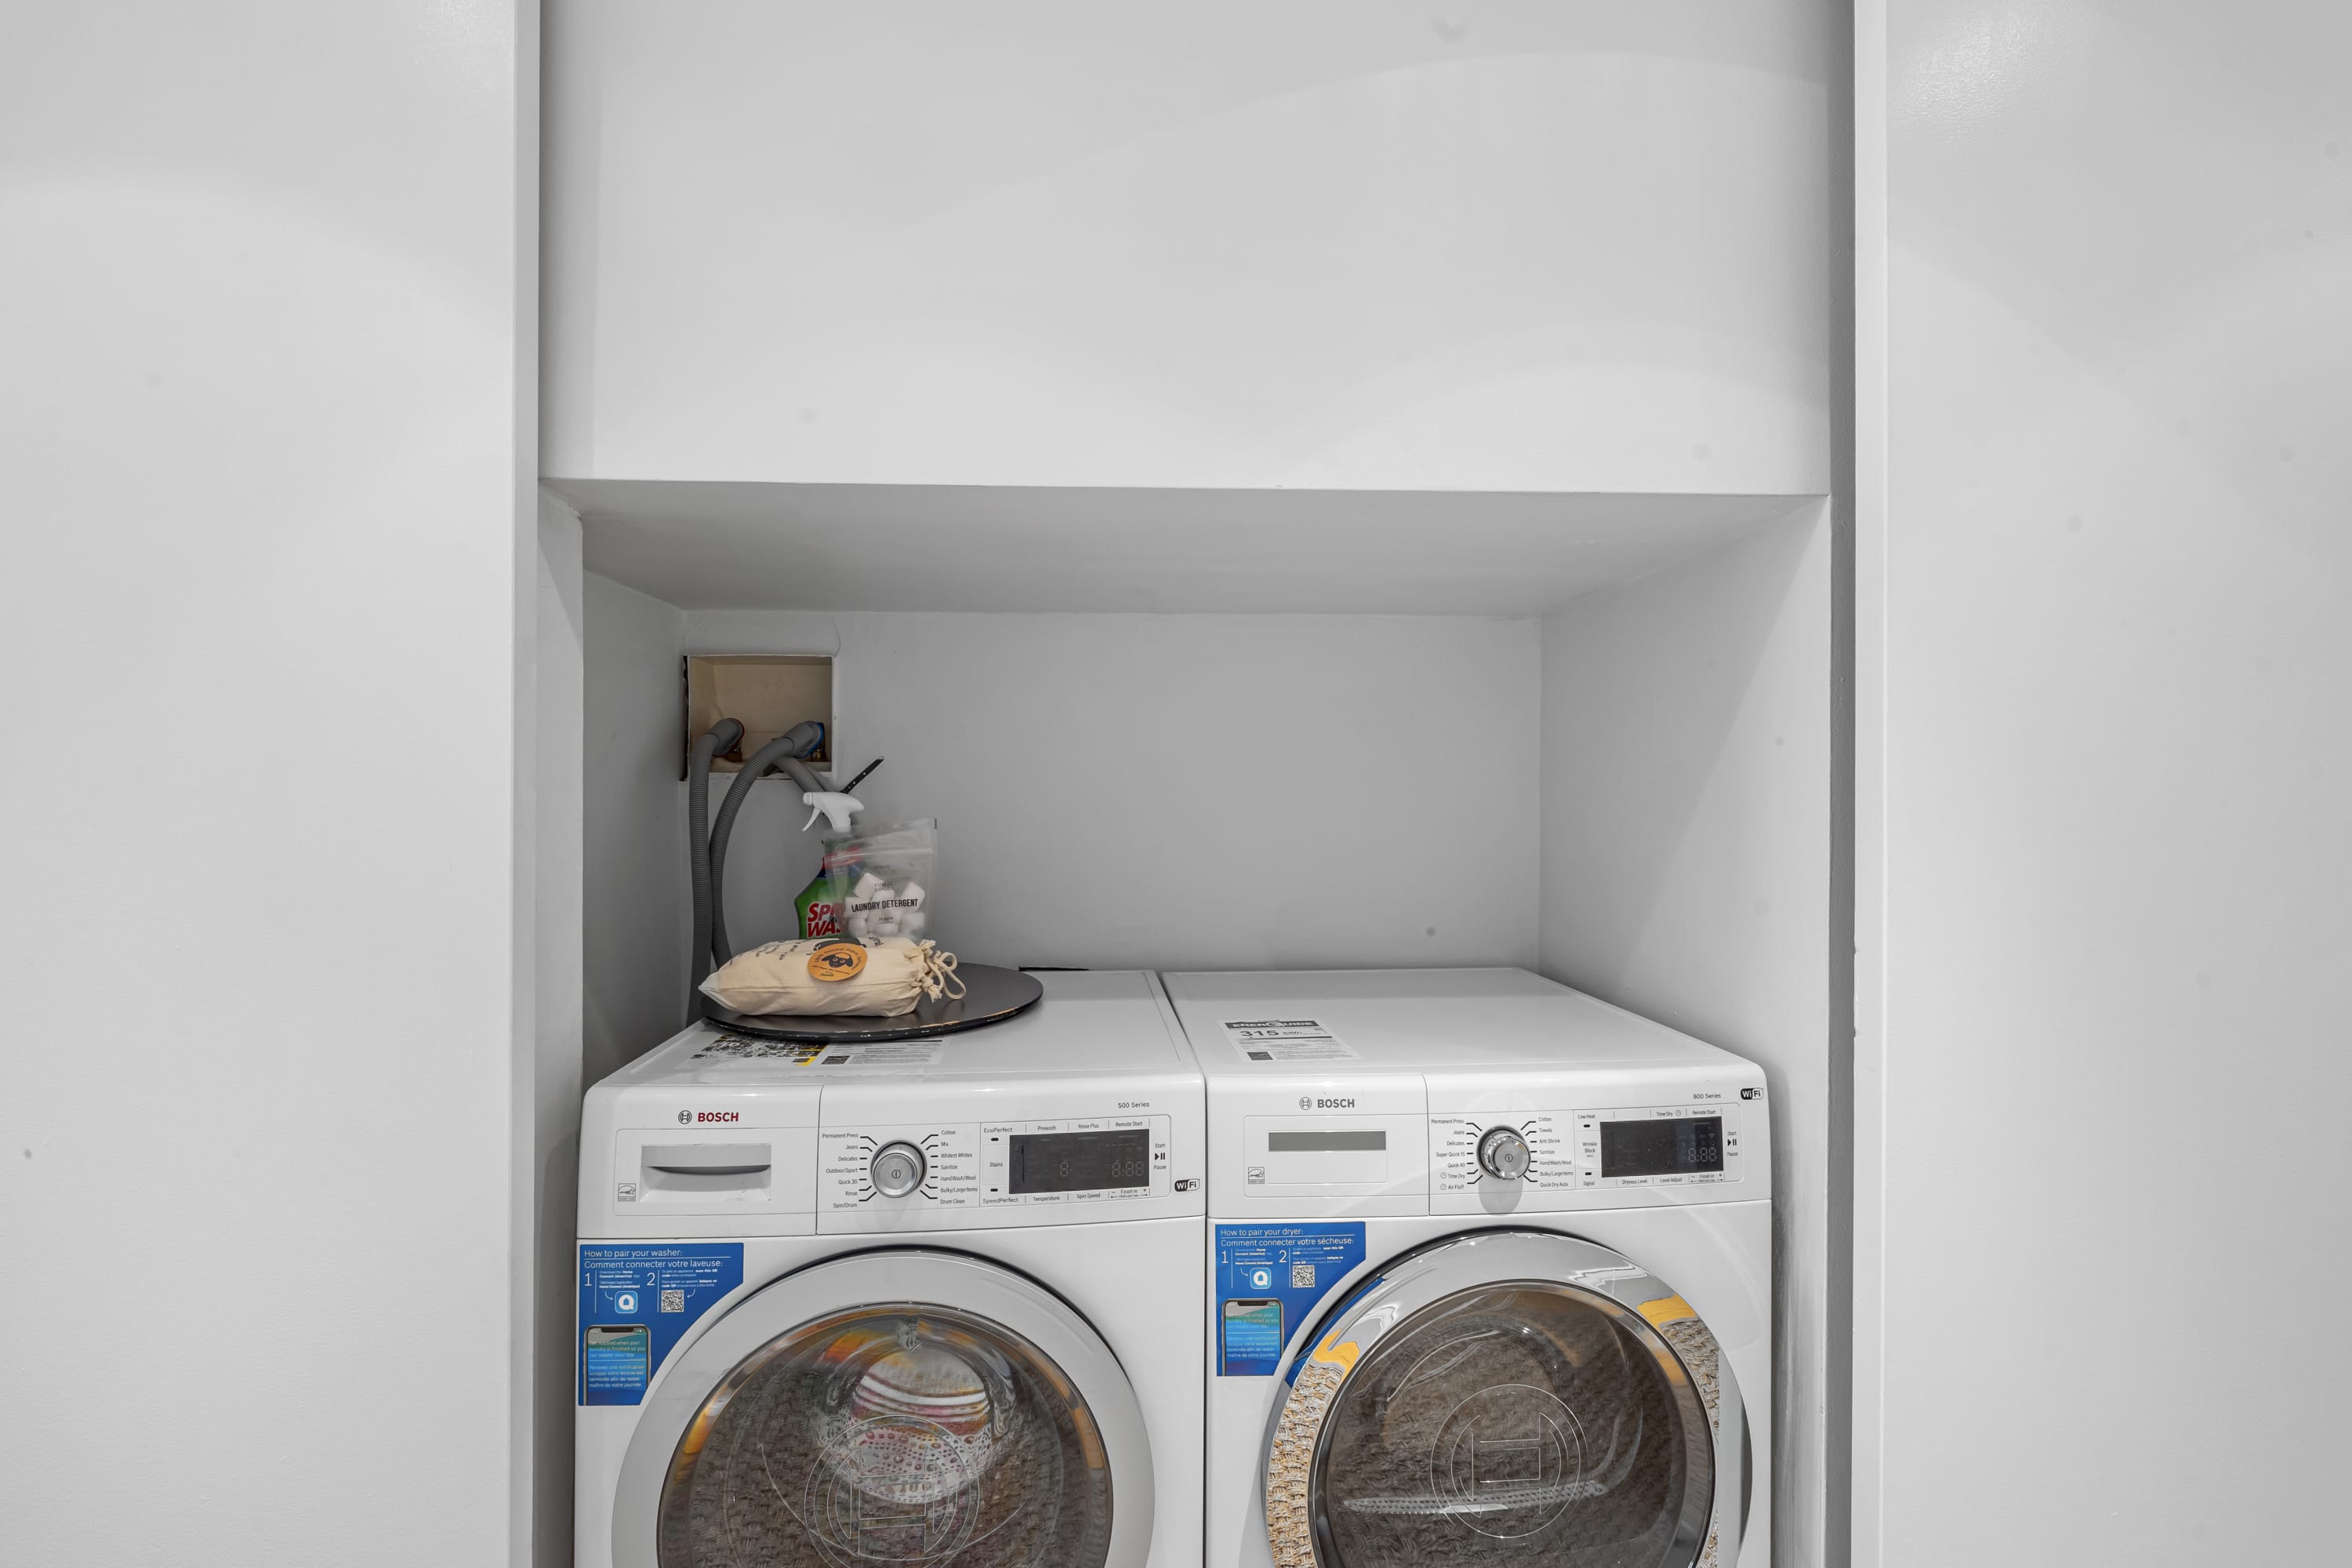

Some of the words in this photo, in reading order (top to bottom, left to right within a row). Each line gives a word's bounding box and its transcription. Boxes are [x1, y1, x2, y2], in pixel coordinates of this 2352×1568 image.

[851, 902, 880, 913] LAUNDRY
[882, 899, 918, 909] DETERGENT
[1317, 1099, 1355, 1109] BOSCH
[698, 1112, 739, 1123] BOSCH
[1283, 1228, 1304, 1236] dryer:
[615, 1249, 630, 1258] pair
[631, 1250, 649, 1258] your
[1221, 1250, 1229, 1264] 1
[1279, 1250, 1287, 1263] 2
[584, 1272, 592, 1287] 1
[647, 1272, 655, 1286] 2
